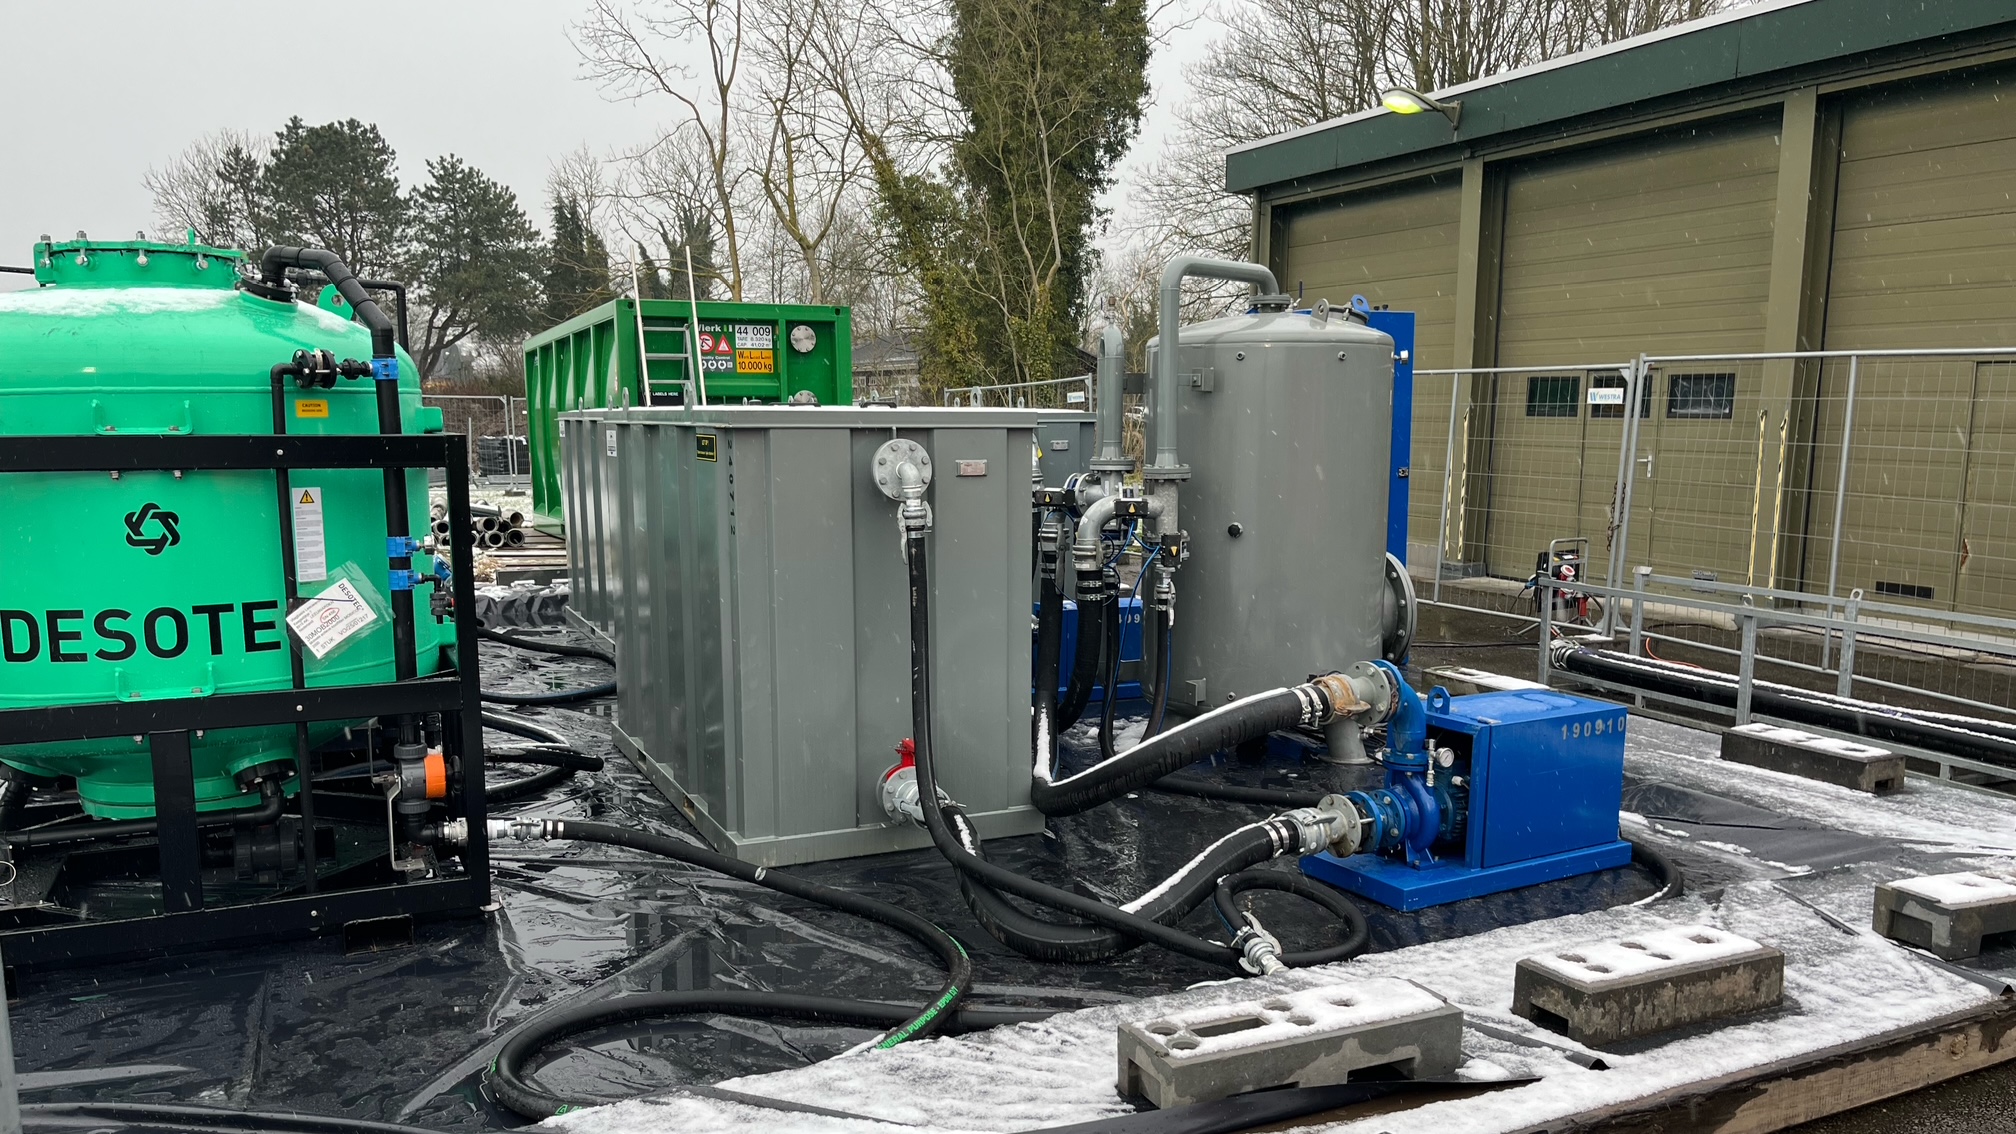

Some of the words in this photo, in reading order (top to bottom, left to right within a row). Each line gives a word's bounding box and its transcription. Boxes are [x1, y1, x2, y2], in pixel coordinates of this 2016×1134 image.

[736, 326, 748, 336] 44
[752, 326, 771, 337] 009
[738, 361, 763, 371] 10.000
[763, 361, 773, 373] kg
[339, 583, 363, 611] DESOTEC
[0, 599, 282, 663] DESOTE
[320, 637, 336, 649] STUK
[1561, 716, 1625, 740] 190910
[907, 1007, 938, 1033] PURPOSE
